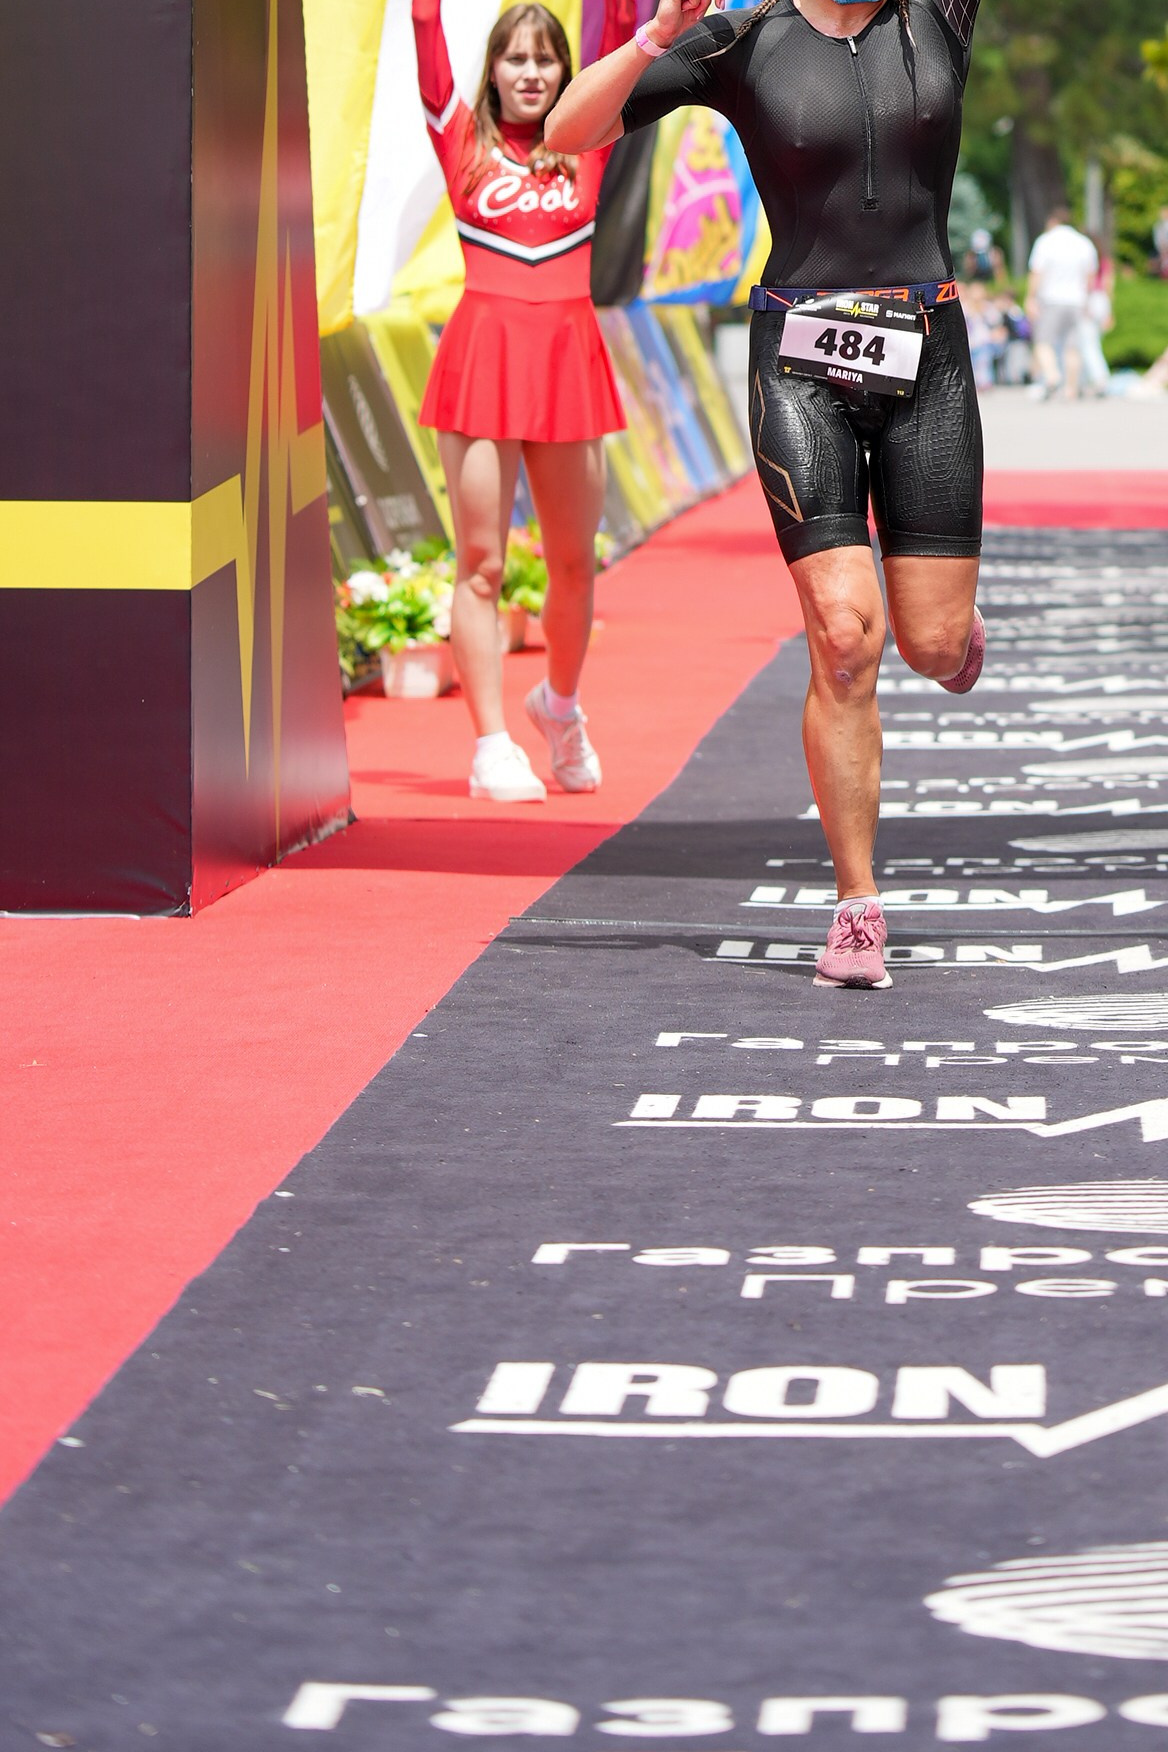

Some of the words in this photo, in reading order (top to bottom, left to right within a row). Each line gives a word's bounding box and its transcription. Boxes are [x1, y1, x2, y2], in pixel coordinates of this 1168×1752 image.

[477, 175, 579, 218] Cool
[860, 301, 880, 314] STAR
[814, 327, 885, 366] 484
[826, 366, 863, 384] MARIYA
[630, 1093, 1047, 1120] IRON
[477, 1361, 1047, 1419] IRON
